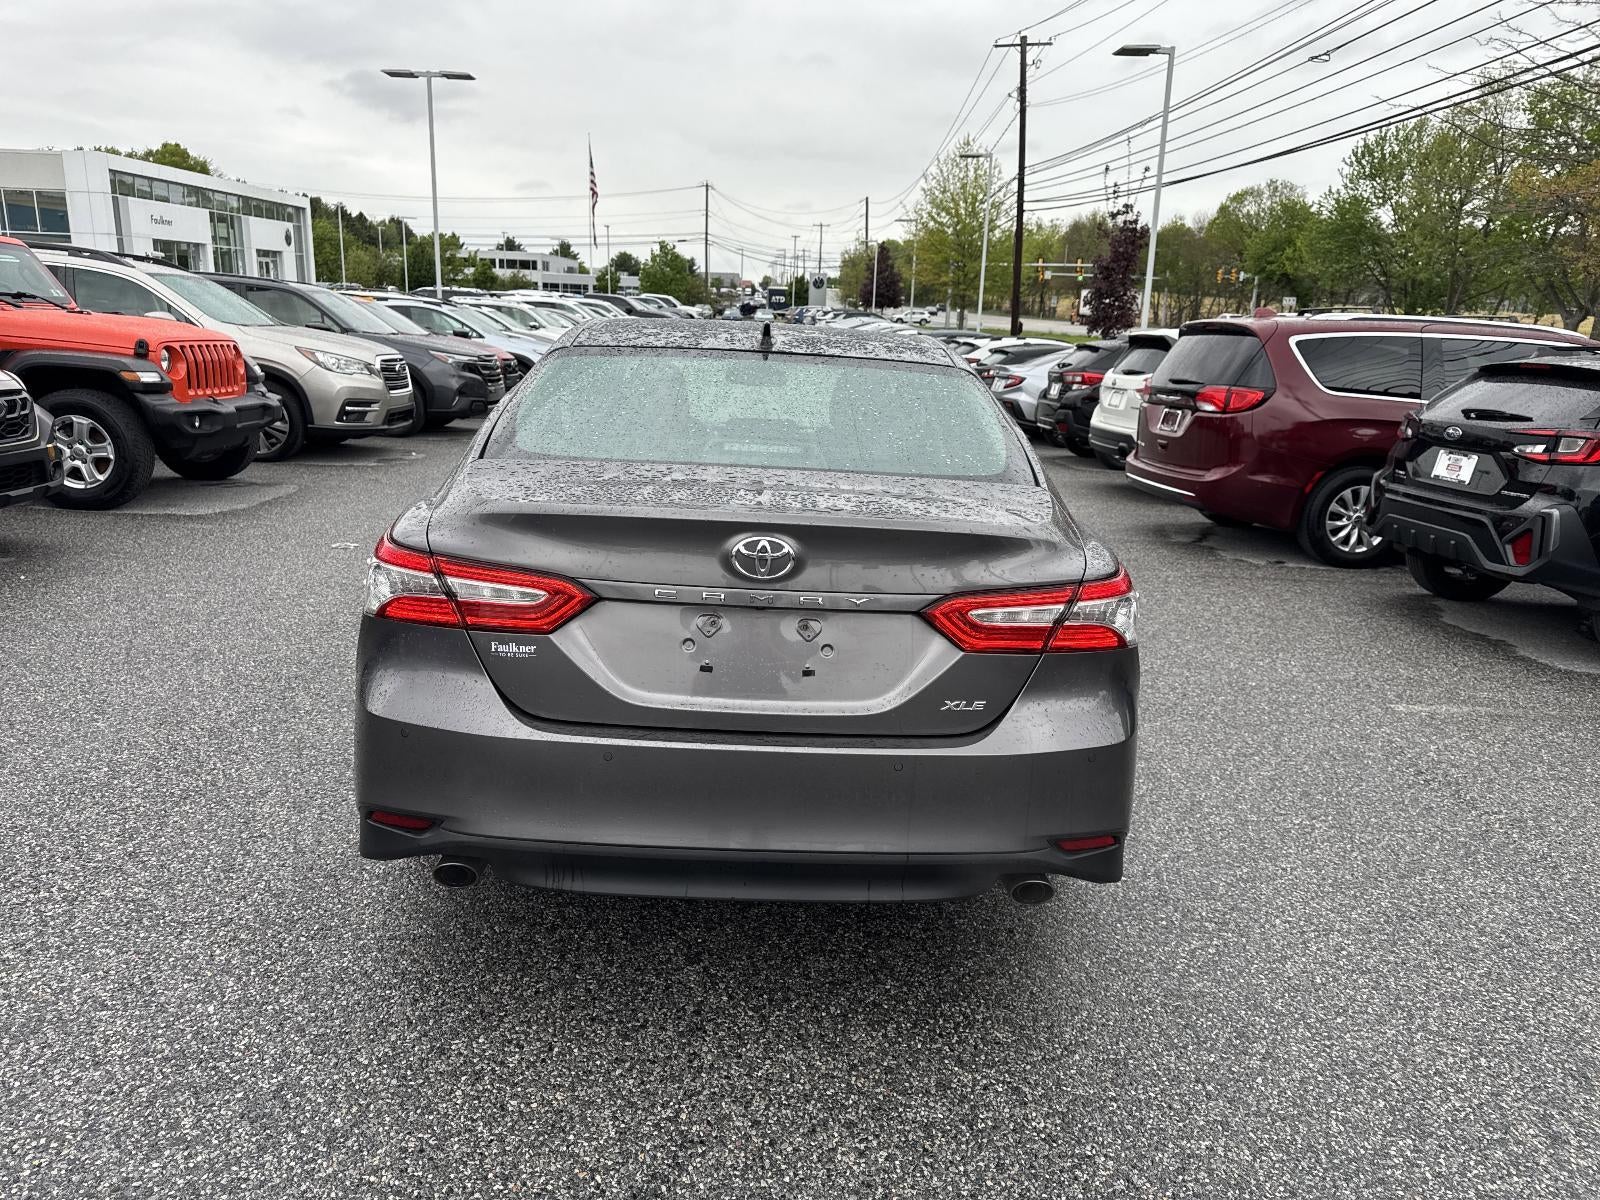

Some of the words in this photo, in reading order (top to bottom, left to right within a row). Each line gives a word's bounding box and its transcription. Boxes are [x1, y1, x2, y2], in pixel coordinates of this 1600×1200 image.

[150, 214, 173, 226] Faulkner
[771, 295, 786, 303] ATD
[654, 588, 874, 607] CAMRY
[490, 641, 537, 653] Faulkner
[940, 700, 987, 711] XLE
